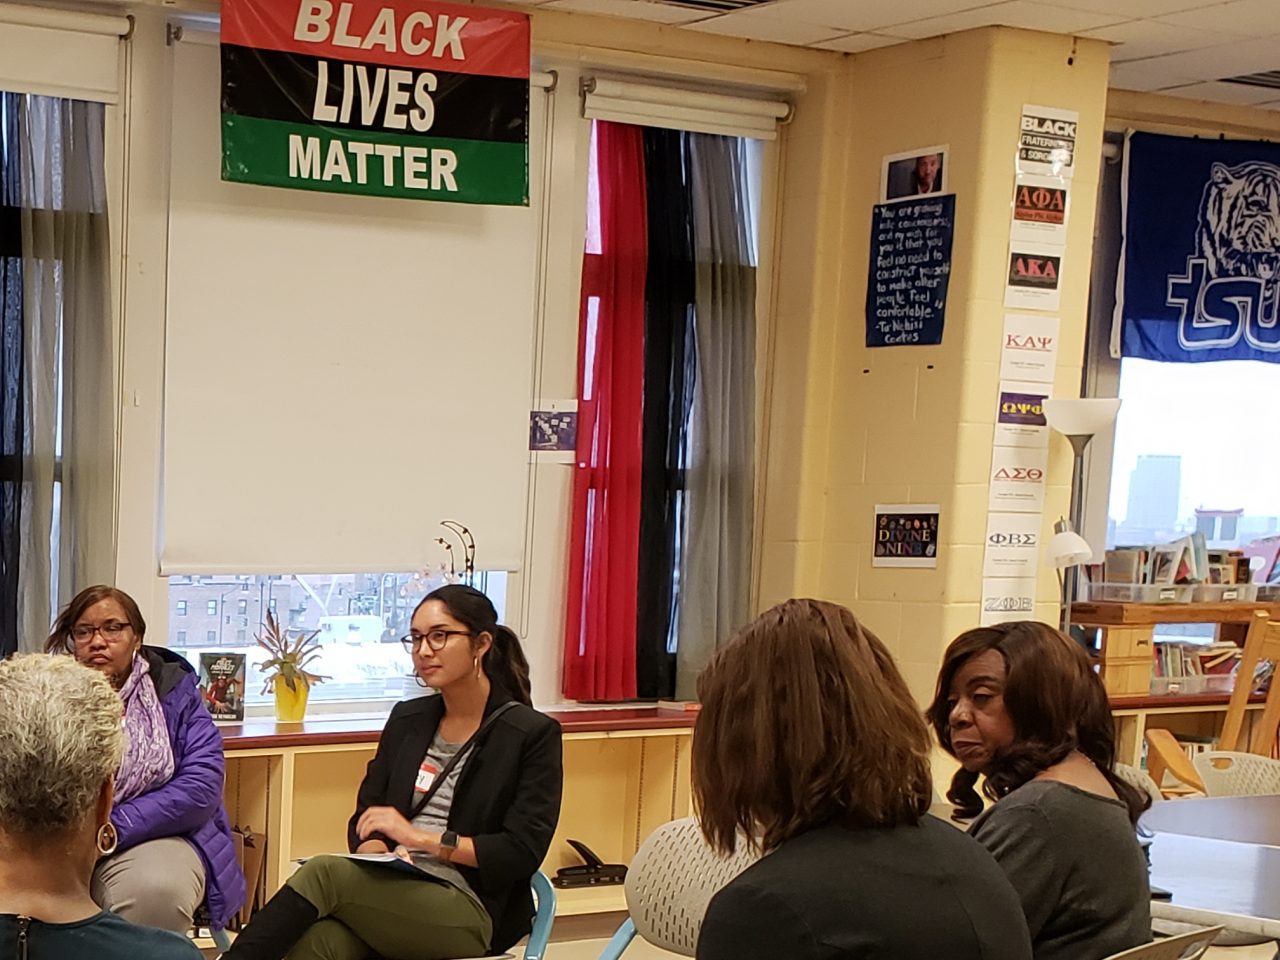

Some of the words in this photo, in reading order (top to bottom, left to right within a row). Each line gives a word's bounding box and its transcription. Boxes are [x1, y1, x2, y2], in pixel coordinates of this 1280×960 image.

[293, 0, 469, 60] BLACK
[312, 60, 438, 132] LIVES
[1021, 117, 1076, 137] BLACK
[288, 134, 458, 191] MATTER
[905, 237, 924, 249] that
[933, 249, 943, 260] to
[877, 281, 886, 292] to
[879, 526, 930, 542] DIVINE
[886, 542, 923, 555] NINE
